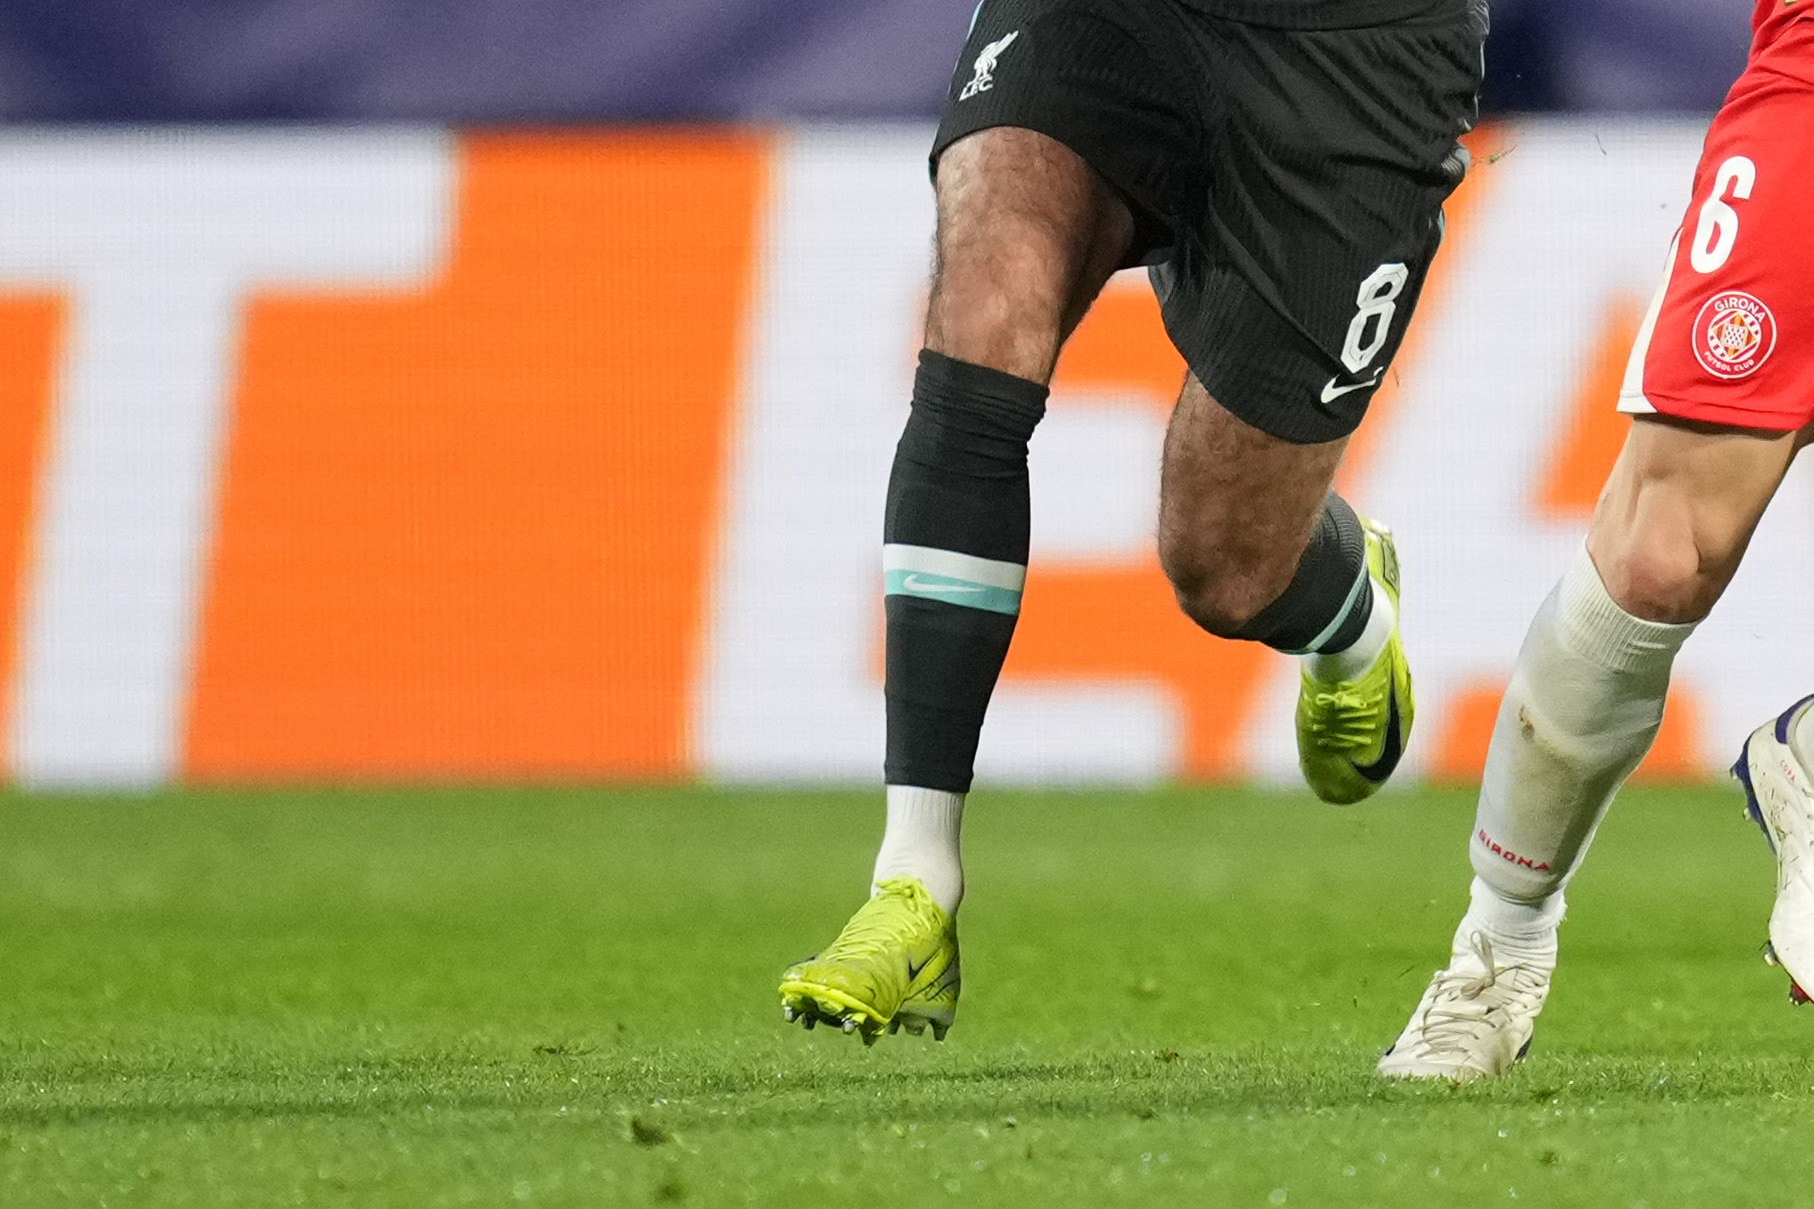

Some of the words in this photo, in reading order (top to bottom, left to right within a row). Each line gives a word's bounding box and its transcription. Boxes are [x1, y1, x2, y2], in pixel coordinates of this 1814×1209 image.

[1690, 155, 1757, 274] 6
[1340, 262, 1409, 374] 8
[1713, 296, 1767, 324] GIRONA
[1703, 350, 1732, 373] FUTBOL
[1734, 358, 1756, 372] CLUB
[1780, 759, 1797, 783] COPA
[1478, 829, 1551, 871] GIRONA
